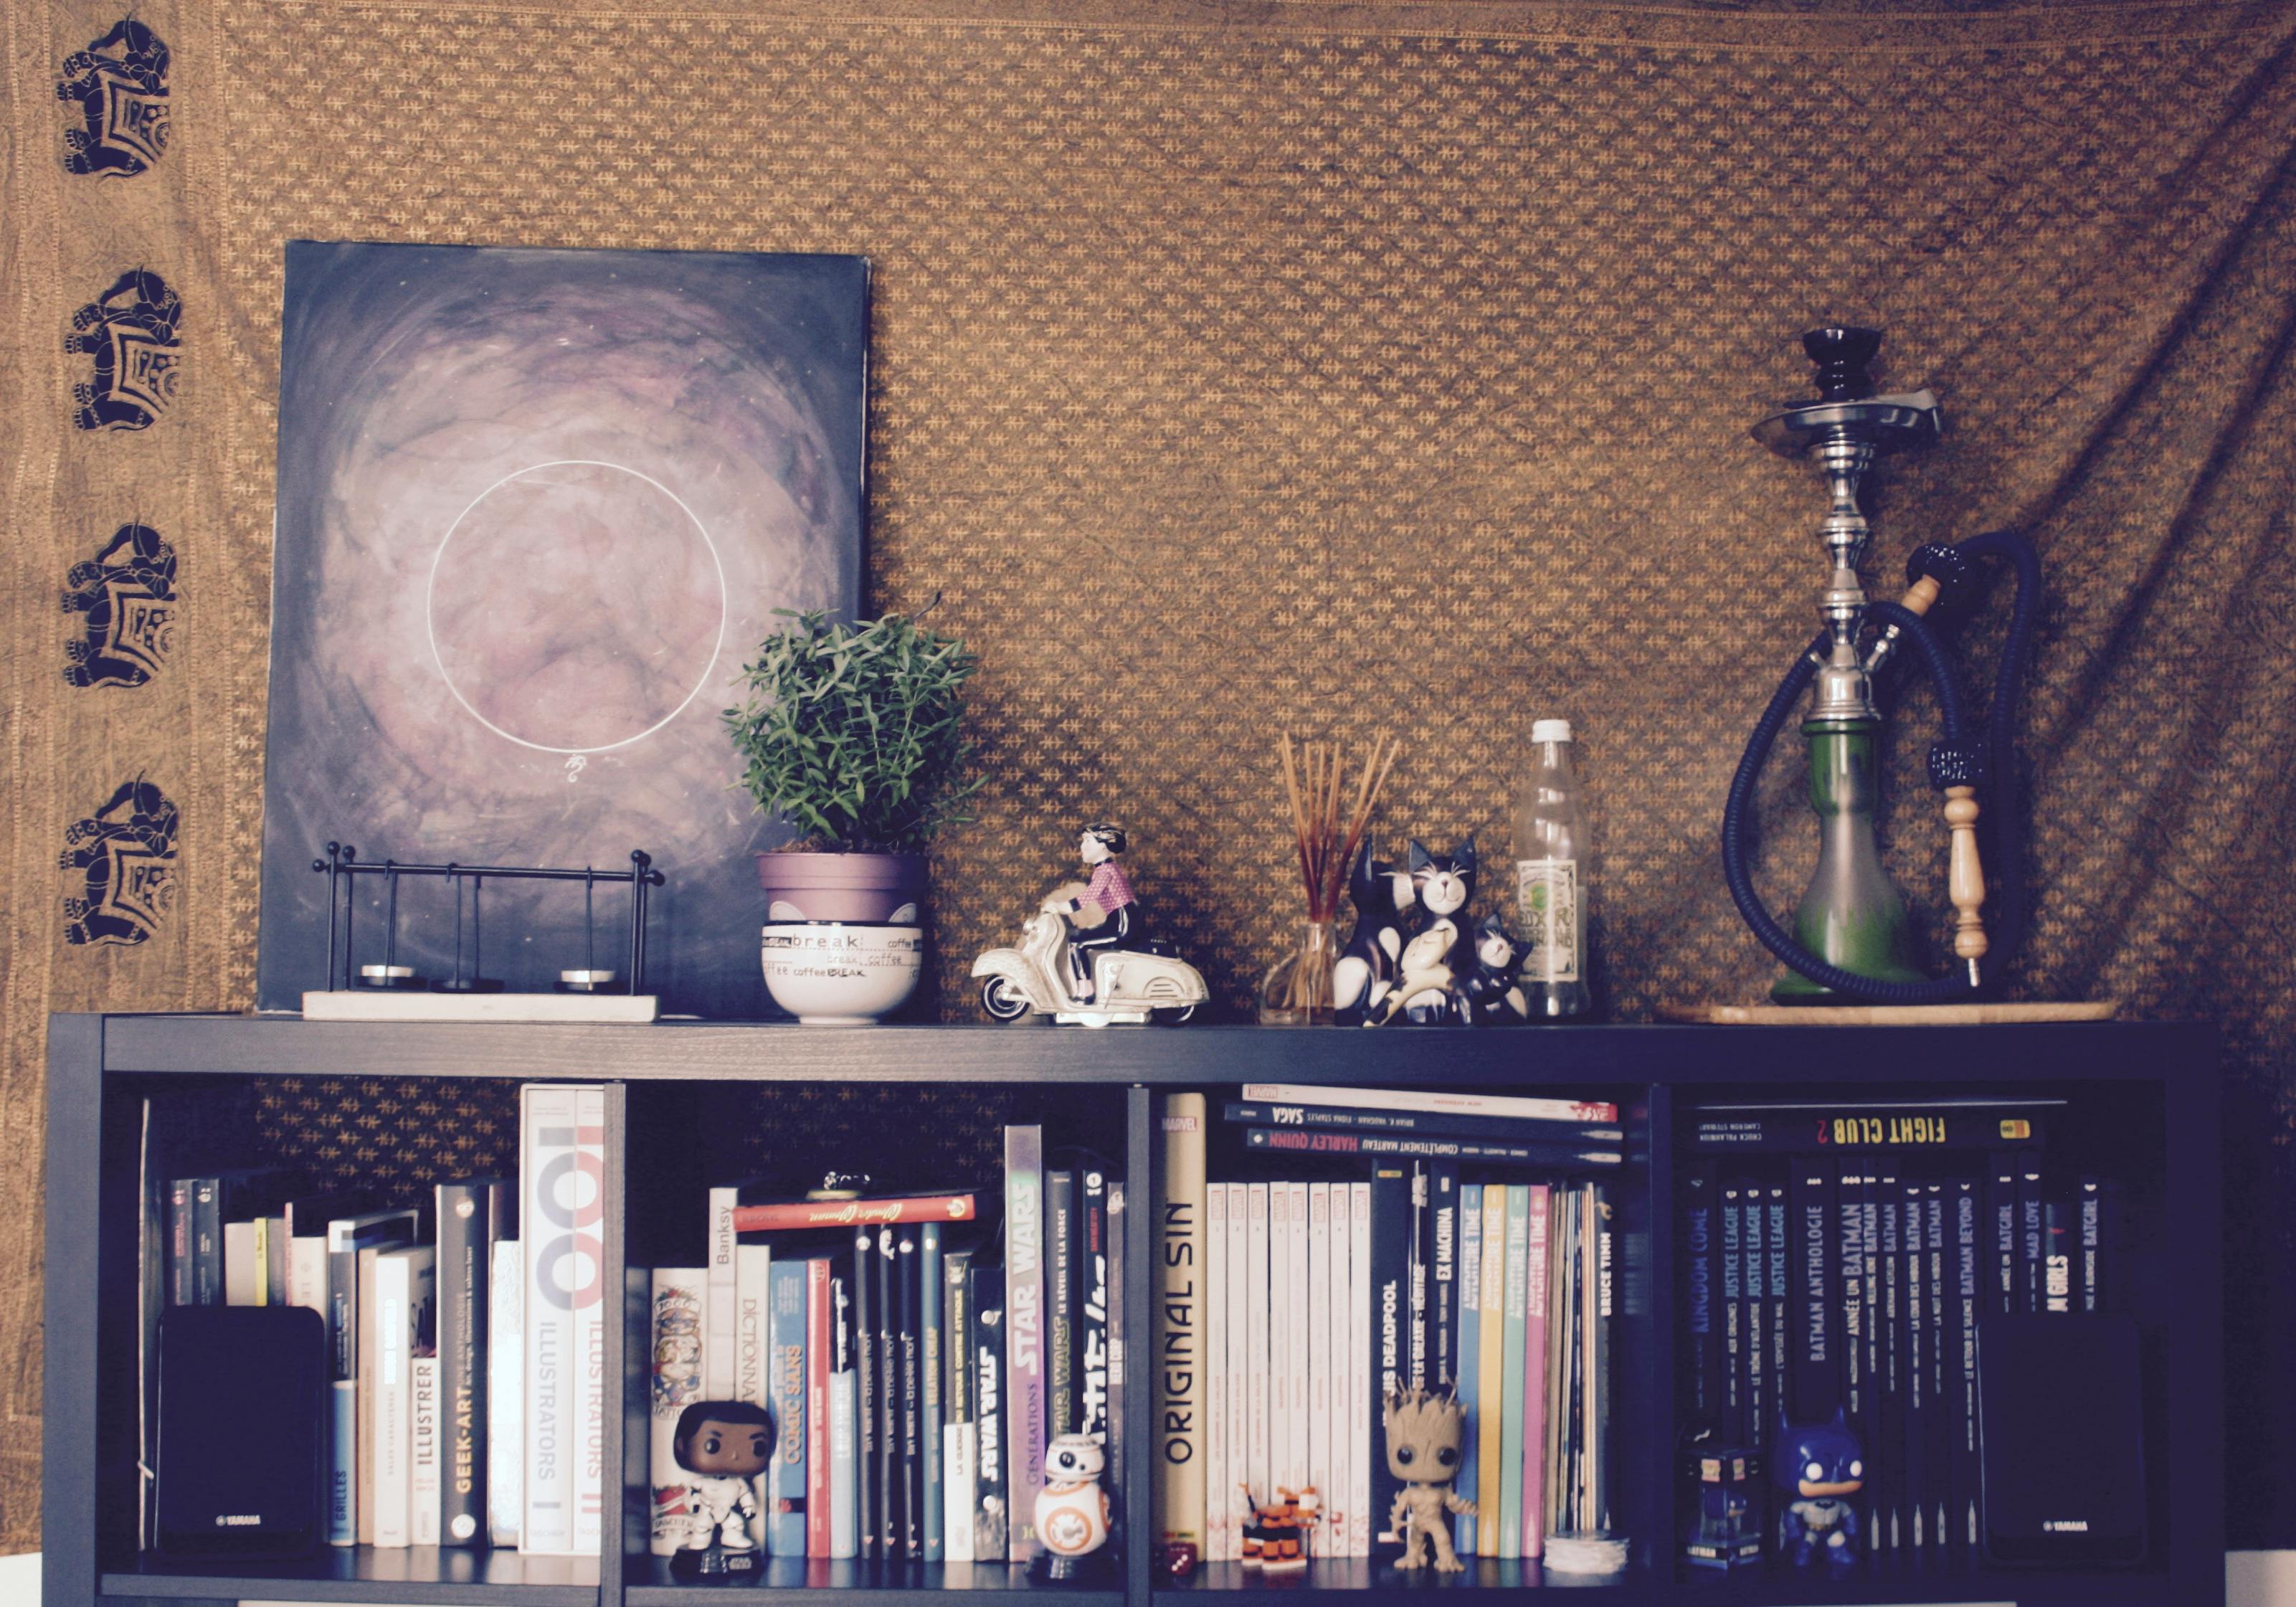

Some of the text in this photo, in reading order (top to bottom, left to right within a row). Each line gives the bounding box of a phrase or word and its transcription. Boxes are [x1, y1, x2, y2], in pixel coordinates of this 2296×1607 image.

[792, 934, 859, 948] break
[868, 953, 901, 964] coffee
[1248, 1085, 1278, 1099] MARVEL
[1272, 1106, 1304, 1124] SAGA
[1162, 1117, 1197, 1132] MARVEL
[1268, 1131, 1309, 1149] QUINN
[1307, 1113, 1332, 1122] STAPLES
[1357, 1117, 1387, 1125] VAUGHAN
[1817, 1117, 1946, 1144] FIGHT CLUB 2
[1312, 1135, 1357, 1152] HARLEY
[1362, 1139, 1398, 1152] MARTEAU
[716, 1205, 733, 1264] Banksy
[1436, 1207, 1452, 1281] EX MACHINA
[1464, 1208, 1481, 1238] TIME
[1486, 1208, 1501, 1238] TIME
[1509, 1215, 1526, 1247] TIME
[1529, 1215, 1546, 1245] TIME
[1725, 1205, 1740, 1251] LEAGUE
[1747, 1204, 1762, 1249] LEAGUE
[1770, 1204, 1785, 1249] LEAGUE
[1864, 1203, 1877, 1253] BATMAN
[1883, 1204, 1897, 1252] BATMAN
[1907, 1203, 1921, 1251] BATMAN
[1928, 1200, 1942, 1248] BATMAN
[1960, 1197, 1974, 1244] BEYOND
[1998, 1204, 2012, 1251] BATGIRL
[2026, 1200, 2039, 1259] MAD LOVE
[2083, 1198, 2097, 1246] BATGIRL
[1012, 1182, 1037, 1376] STAR WARS
[1600, 1232, 1611, 1317] BRUCE TIMM
[1690, 1208, 1709, 1332] KINGDOM COME
[1725, 1253, 1740, 1298] JUSTICE
[1747, 1251, 1762, 1297] JUSTICE
[1770, 1251, 1785, 1296] JUSTICE
[1806, 1205, 1826, 1361] BATMAN ANTHOLOGIE
[1841, 1203, 1862, 1336] ANNÉE UN BATMAN
[1960, 1247, 1974, 1295] BATMAN
[2046, 1255, 2068, 1296] GIRLS
[456, 1292, 465, 1367] ANTHOLOGIE
[1053, 1209, 1070, 1436] TAR WARS LE RÉVEIL DE LA FORCE
[1166, 1203, 1192, 1464] ORIGINAL SIN
[1383, 1280, 1396, 1367] DEADPOOL
[741, 1298, 760, 1399] DICTIONNA
[417, 1366, 432, 1465] ILLUSTRER
[538, 1322, 557, 1481] ILLUSTRATORS
[587, 1321, 602, 1479] ILLUSTRATORS
[785, 1345, 802, 1464] COMIC SANS
[979, 1347, 998, 1482] STAR WARS
[456, 1386, 472, 1494] GEEK-ART
[1026, 1383, 1040, 1485] GÉNÉRATIONS
[227, 1515, 261, 1525] YAMAHA
[336, 1470, 348, 1522] GRILLES
[2054, 1521, 2088, 1532] YAMAHA
